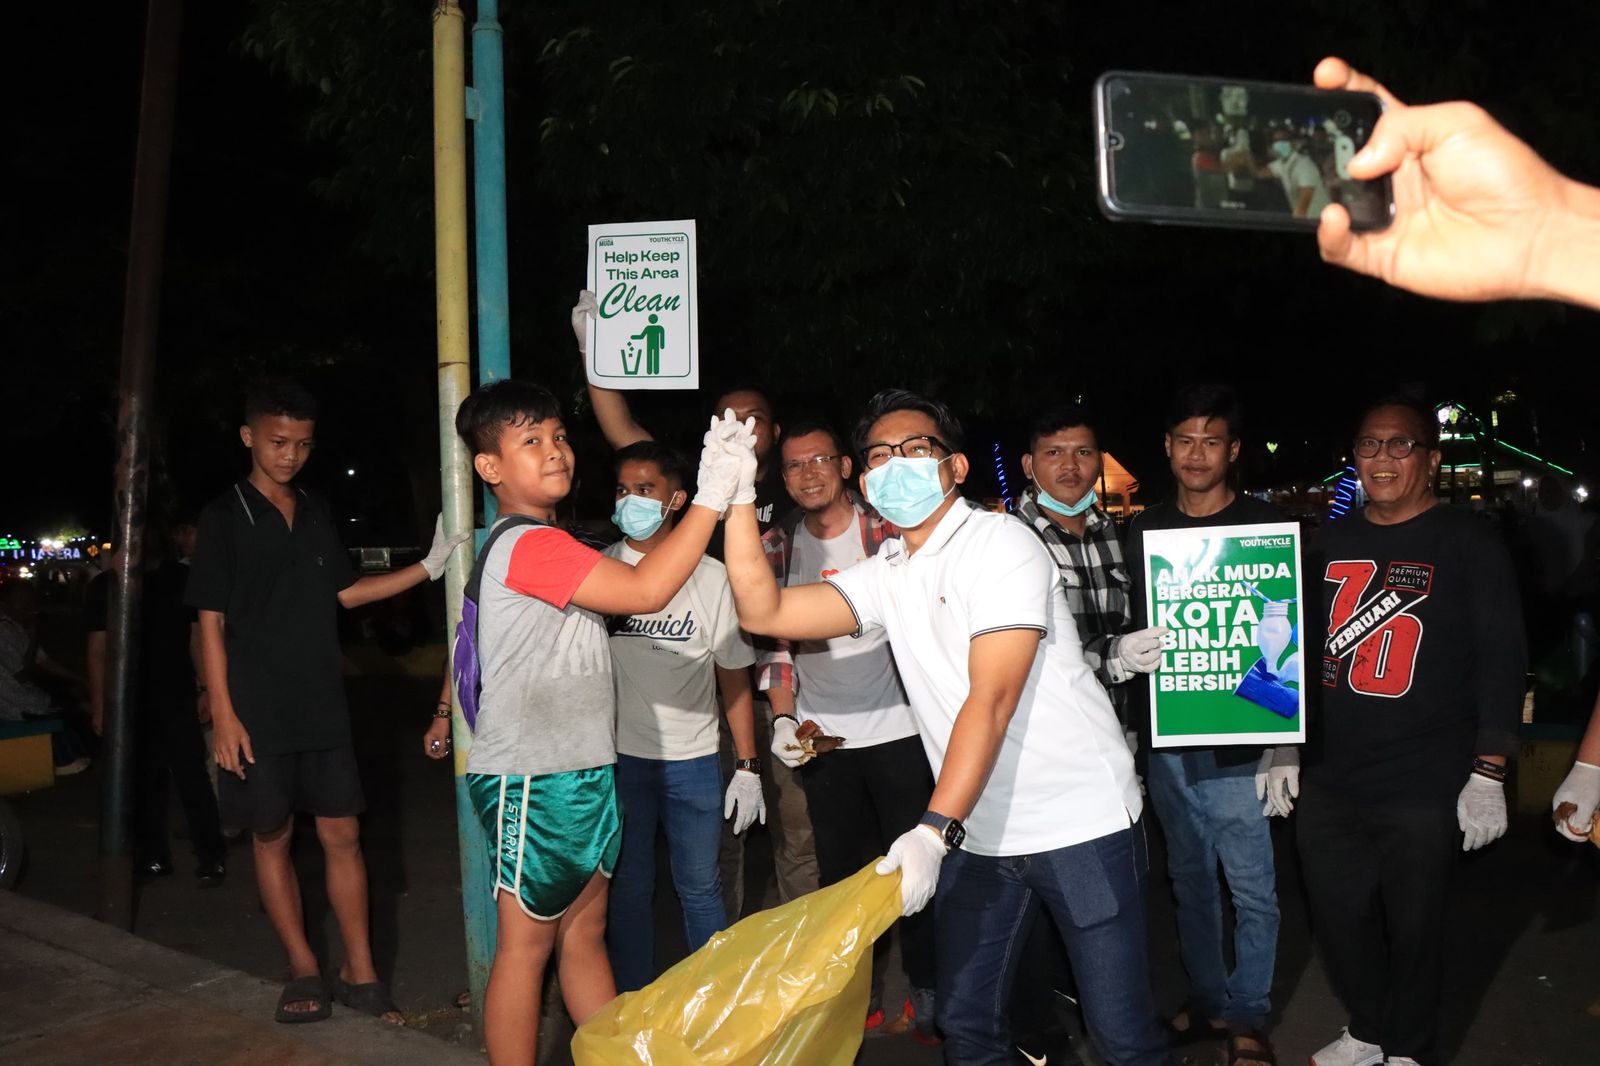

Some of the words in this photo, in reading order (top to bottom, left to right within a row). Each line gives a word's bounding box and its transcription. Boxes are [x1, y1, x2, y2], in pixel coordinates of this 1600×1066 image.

[605, 251, 638, 265] Help
[641, 249, 680, 263] Keep
[606, 268, 638, 280] This
[641, 268, 679, 279] Area
[599, 282, 680, 319] Clean
[1240, 537, 1291, 547] YOUTHCYCLE
[1224, 562, 1292, 581] MUDA
[1388, 576, 1428, 586] QUALITY
[1389, 567, 1429, 578] PREMIUM
[1157, 582, 1259, 601] BERGERAK
[1157, 600, 1259, 628] KOTA
[1329, 591, 1402, 655] FEBRUARI
[1160, 650, 1241, 673] LEBIH
[1160, 673, 1243, 692] BERSIH
[505, 803, 518, 860] STORM
